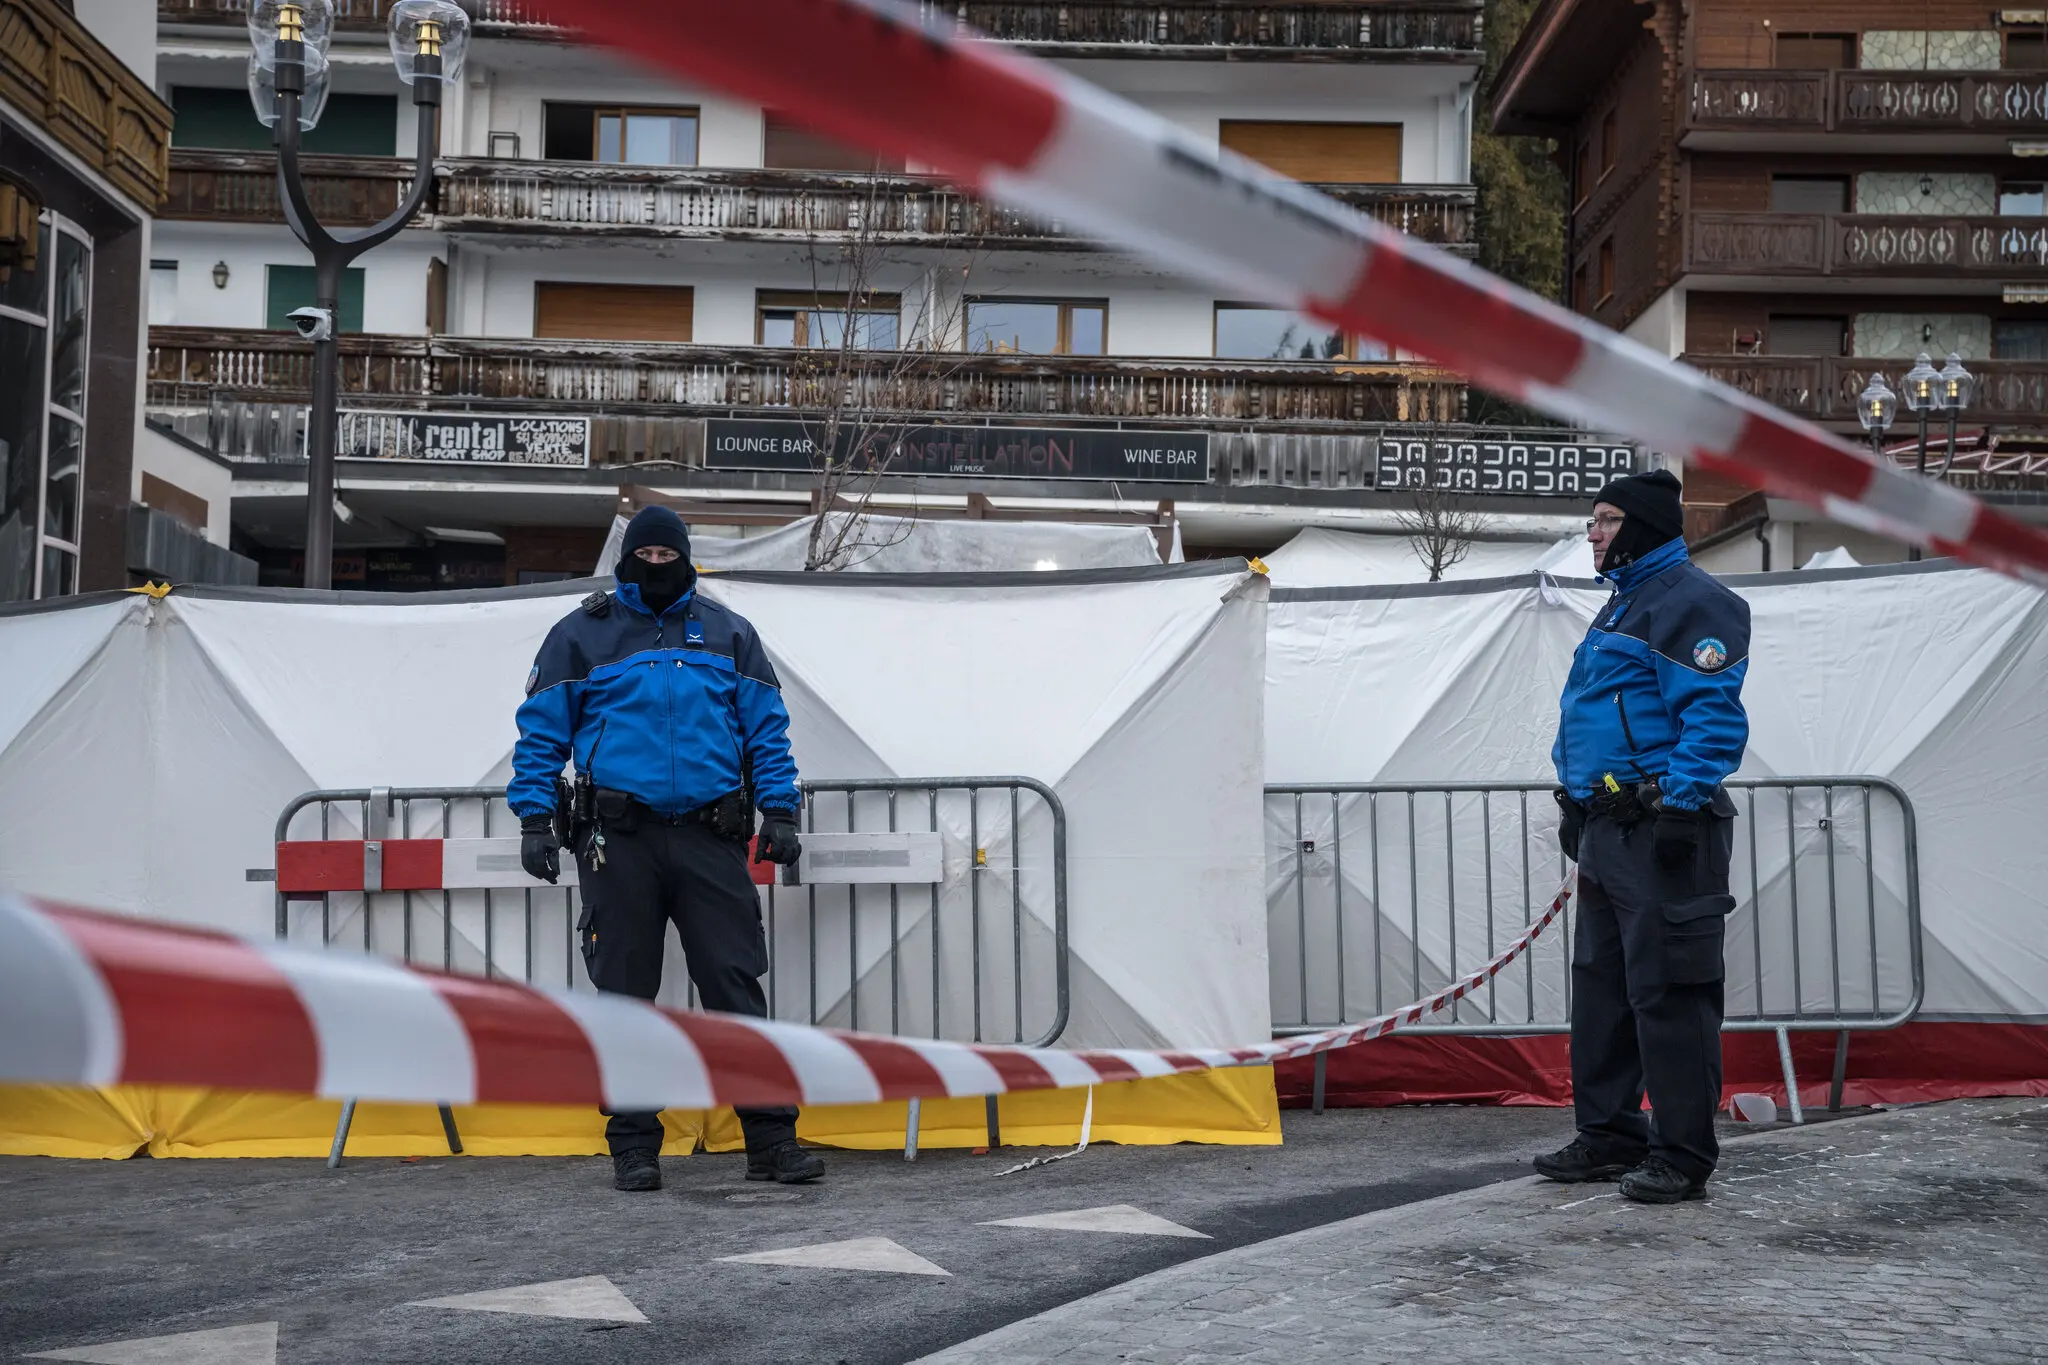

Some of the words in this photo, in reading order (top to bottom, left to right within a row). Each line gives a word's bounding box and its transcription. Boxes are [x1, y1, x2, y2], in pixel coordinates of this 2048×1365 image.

[509, 420, 585, 434] LOCATIONS
[425, 421, 505, 450] rental
[525, 442, 572, 455] VENTE
[716, 437, 778, 453] LOUNGE
[782, 439, 813, 454] BAR
[424, 448, 467, 460] SPORT
[471, 449, 506, 461] SHOP
[1123, 448, 1163, 464] WINE
[1166, 450, 1198, 465] BAR
[949, 464, 964, 472] LIVE
[964, 464, 986, 473] MUSIC
